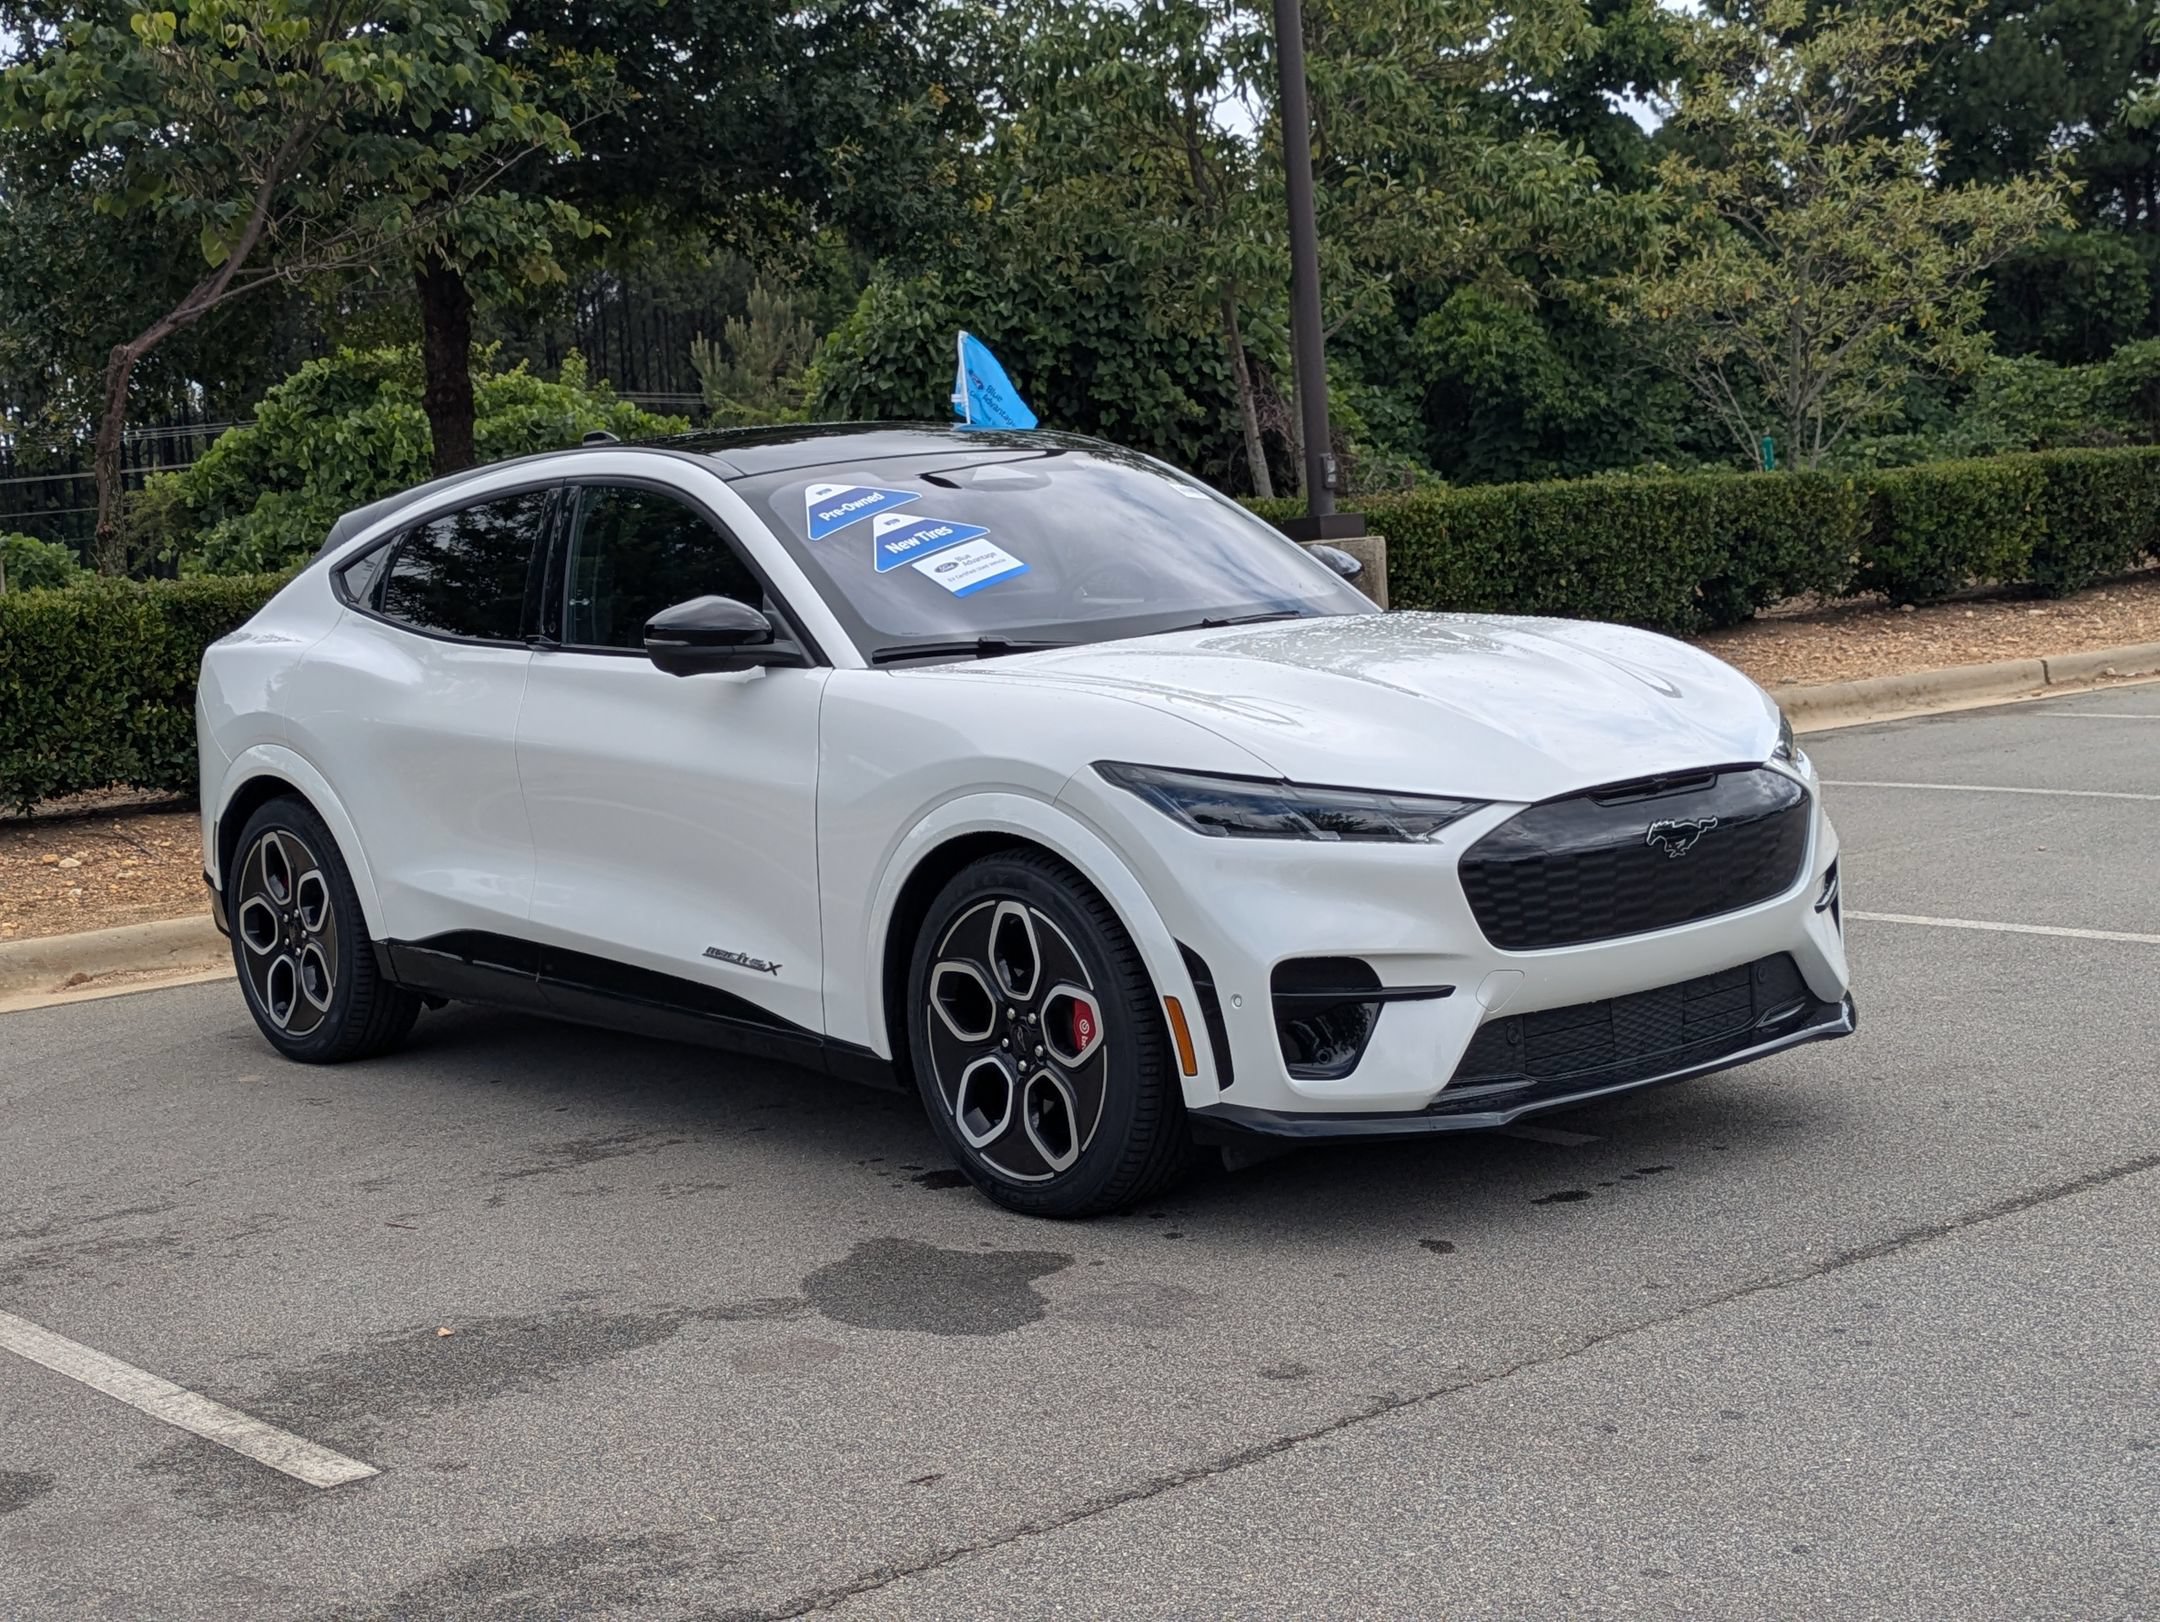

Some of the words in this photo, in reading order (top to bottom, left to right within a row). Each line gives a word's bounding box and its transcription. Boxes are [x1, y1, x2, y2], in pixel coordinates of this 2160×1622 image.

[986, 385, 1003, 401] Blue
[818, 492, 885, 521] Pre-Owned
[884, 537, 920, 554] New
[914, 526, 954, 541] Tires
